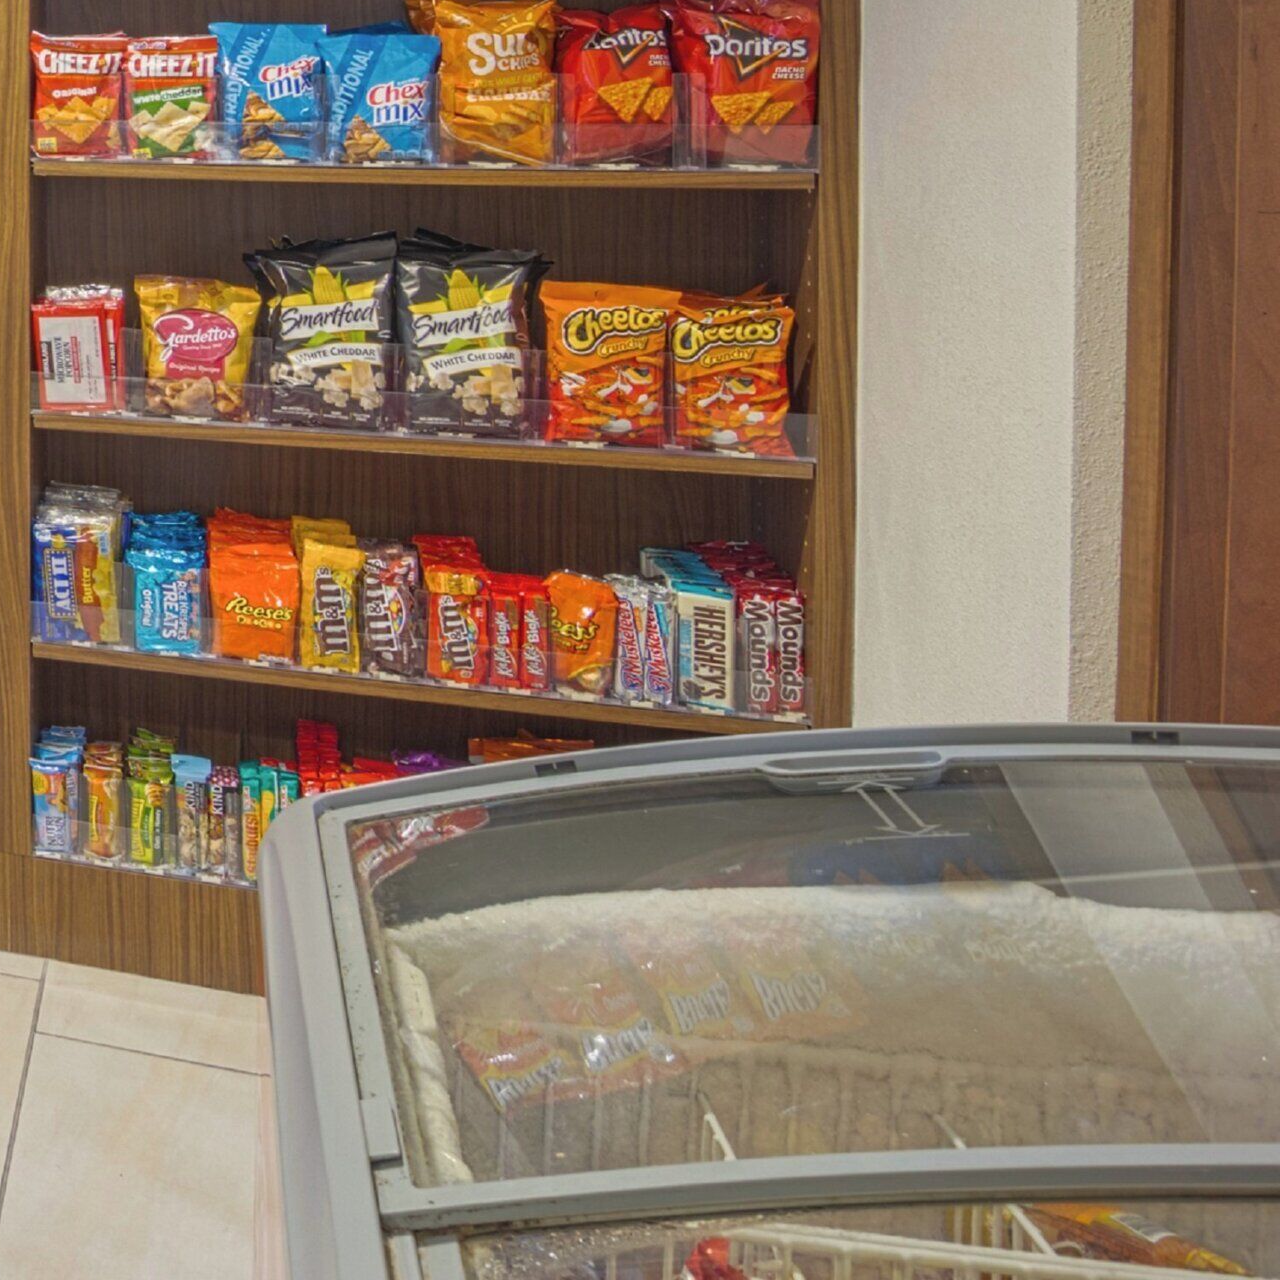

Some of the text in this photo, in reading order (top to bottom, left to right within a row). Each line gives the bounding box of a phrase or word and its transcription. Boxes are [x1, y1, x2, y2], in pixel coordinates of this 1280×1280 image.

[706, 33, 808, 58] Doritos
[39, 51, 124, 77] CHEEZ-IT
[128, 51, 218, 79] CHEEZ-IT
[258, 56, 321, 84] Chex
[498, 53, 540, 72] CHIPS
[268, 76, 316, 100] mix
[367, 80, 427, 107] Chex
[374, 102, 424, 125] mix
[280, 300, 378, 337] Smartfood
[411, 306, 513, 345] Smartfood
[566, 308, 666, 352] Cheetos
[152, 314, 237, 361] Gardetto's
[598, 335, 649, 358] Crunchy
[672, 319, 782, 360] Cheetos
[56, 335, 64, 384] MICROWAVE
[296, 345, 377, 362] WHITE CHEDDAR
[430, 351, 517, 371] WHITE CHEDDAR
[701, 347, 755, 369] Crunchy
[52, 579, 72, 611] ACT
[82, 565, 94, 605] Butter
[178, 579, 189, 600] RICE
[141, 588, 152, 627] original
[161, 581, 177, 642] TREATS
[226, 595, 293, 621] Reese's
[694, 605, 726, 701] HERSHEY'S
[744, 598, 773, 703] Mounds
[777, 600, 803, 705] Mounds
[185, 780, 195, 809] KIND
[211, 784, 224, 816] KIND
